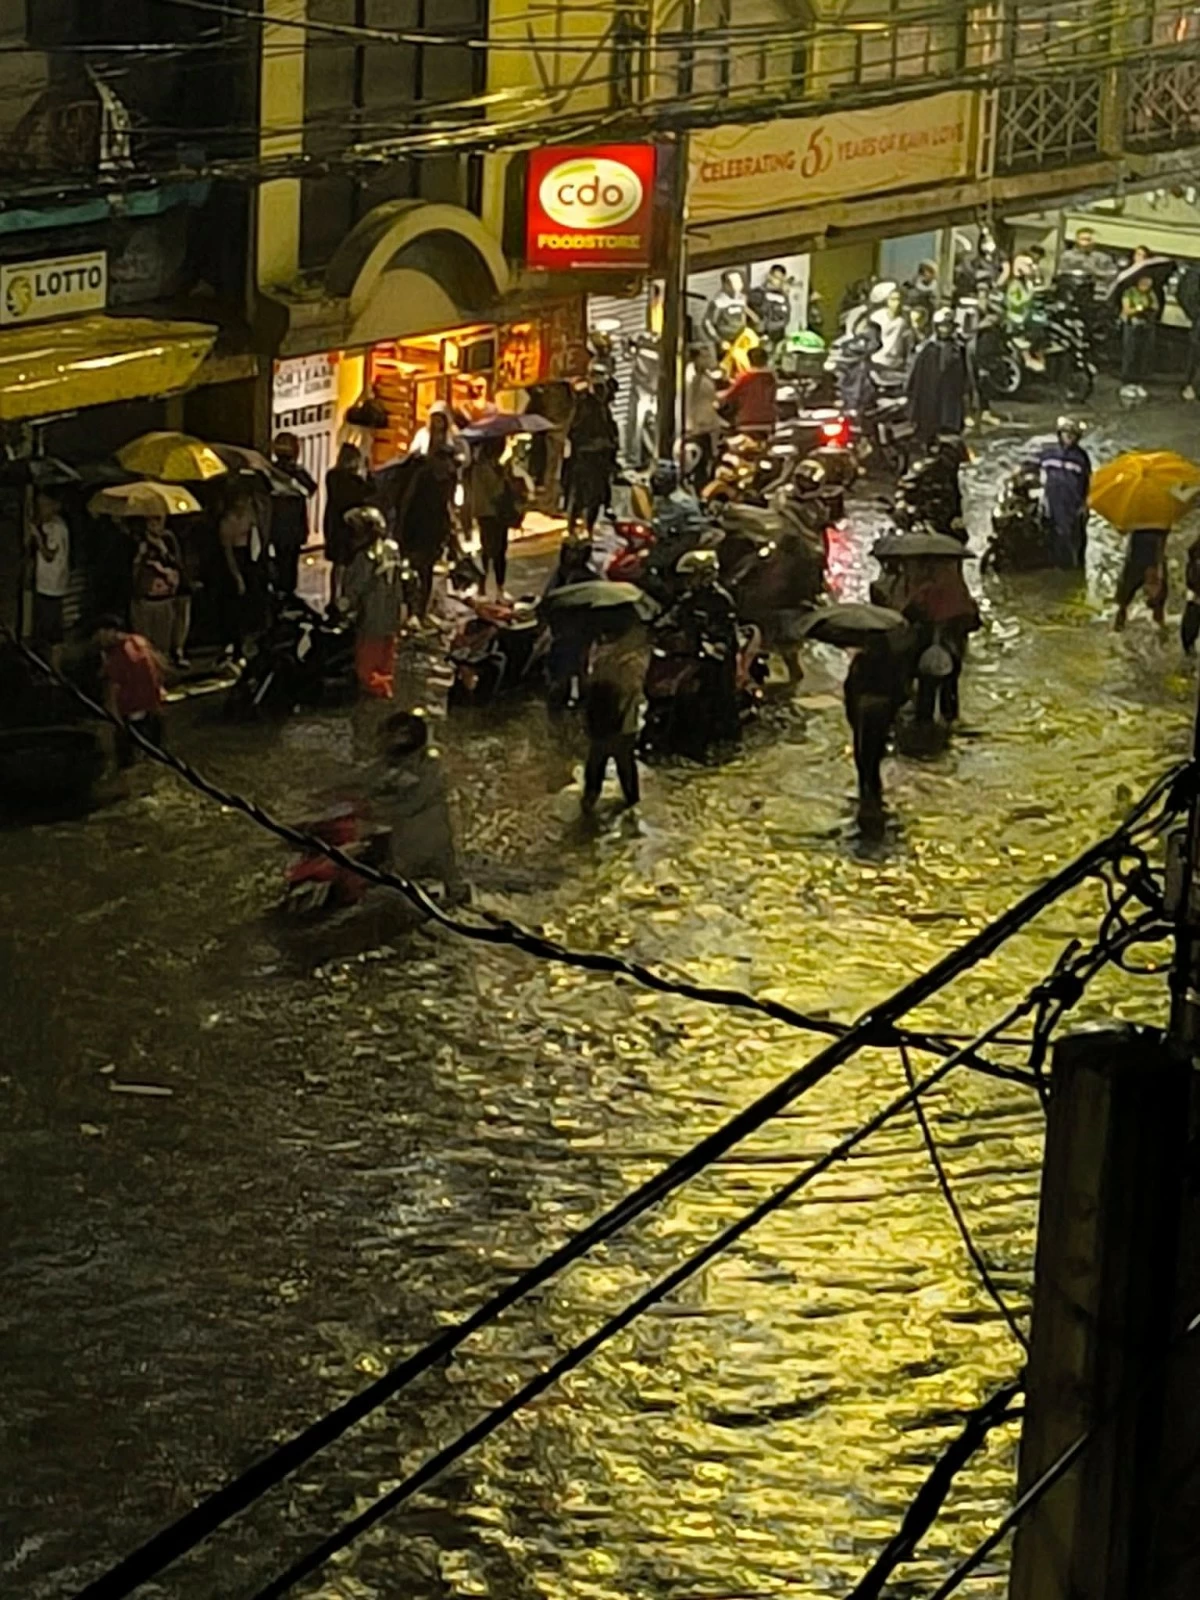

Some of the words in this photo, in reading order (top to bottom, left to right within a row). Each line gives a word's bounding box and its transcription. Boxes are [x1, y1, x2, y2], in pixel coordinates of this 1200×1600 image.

[699, 150, 796, 184] CELEBRATING
[837, 137, 877, 161] YEARS
[878, 131, 896, 154] OF
[557, 175, 624, 207] cdo
[35, 265, 102, 297] LOTTO
